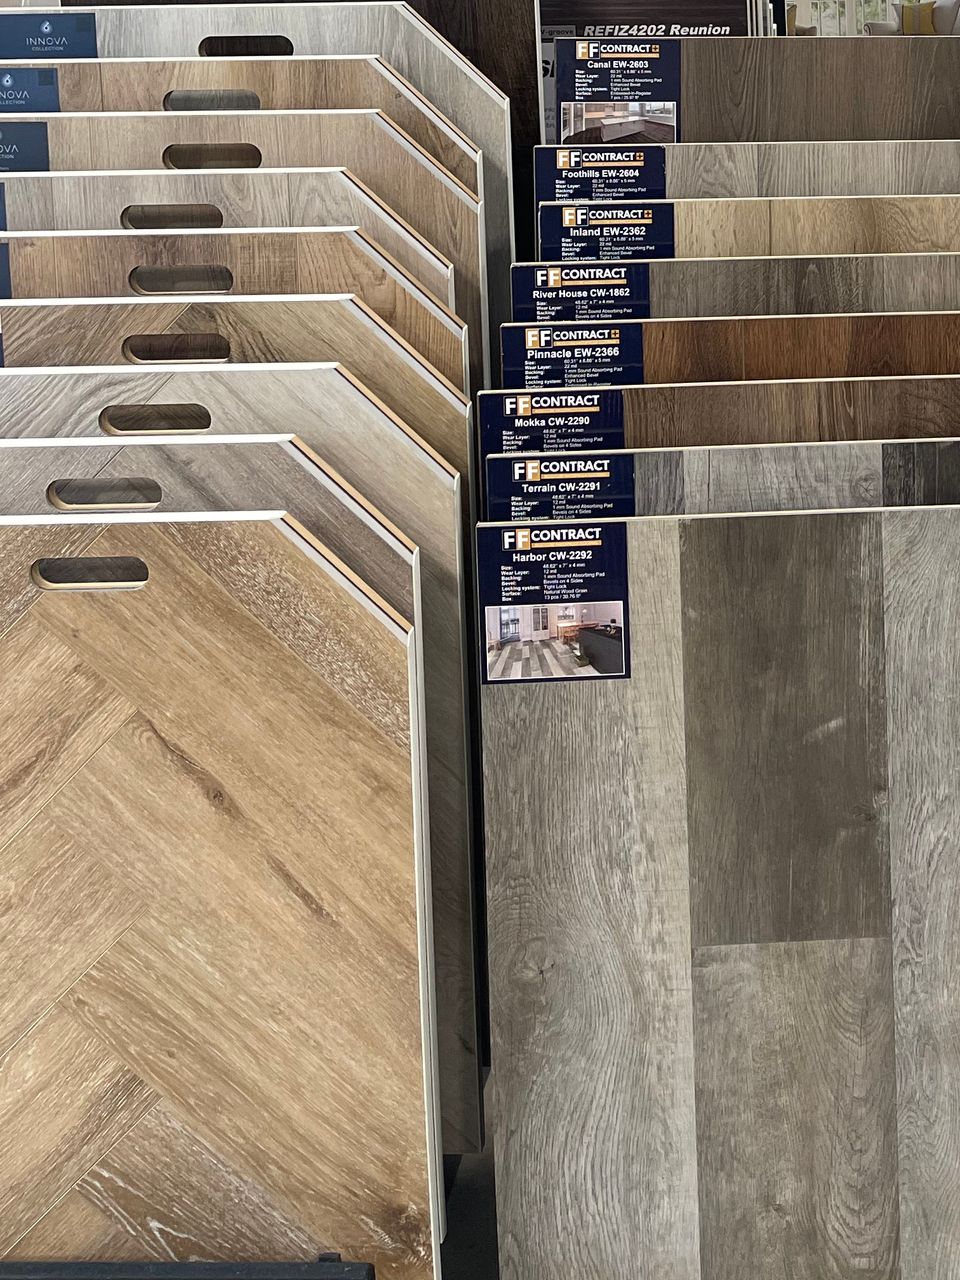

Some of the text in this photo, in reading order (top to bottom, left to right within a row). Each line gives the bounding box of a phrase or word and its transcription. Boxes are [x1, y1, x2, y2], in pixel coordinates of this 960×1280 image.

[584, 25, 730, 36] REFIZ4202 Reunion
[26, 37, 68, 45] INNOVA
[601, 45, 650, 53] CONTRACT
[582, 152, 635, 161] CONTRACT
[562, 170, 599, 178] Foothills
[589, 210, 642, 219] CONTRACT
[570, 227, 646, 236] Inland EW-2362
[562, 268, 627, 279] CONTRACT
[559, 290, 588, 298] House
[590, 289, 630, 297] CW-1862
[553, 330, 609, 340] CONTRACT
[528, 348, 619, 359] Pinnacle EW-2366
[532, 395, 600, 407] CONTRACT
[515, 417, 590, 427] Mokka CW-2290
[541, 460, 610, 472] CONTRACT
[522, 482, 600, 492] Terrain CW-2291
[531, 528, 601, 541] CONTRACT
[513, 551, 592, 562] Harbor CW-2292
